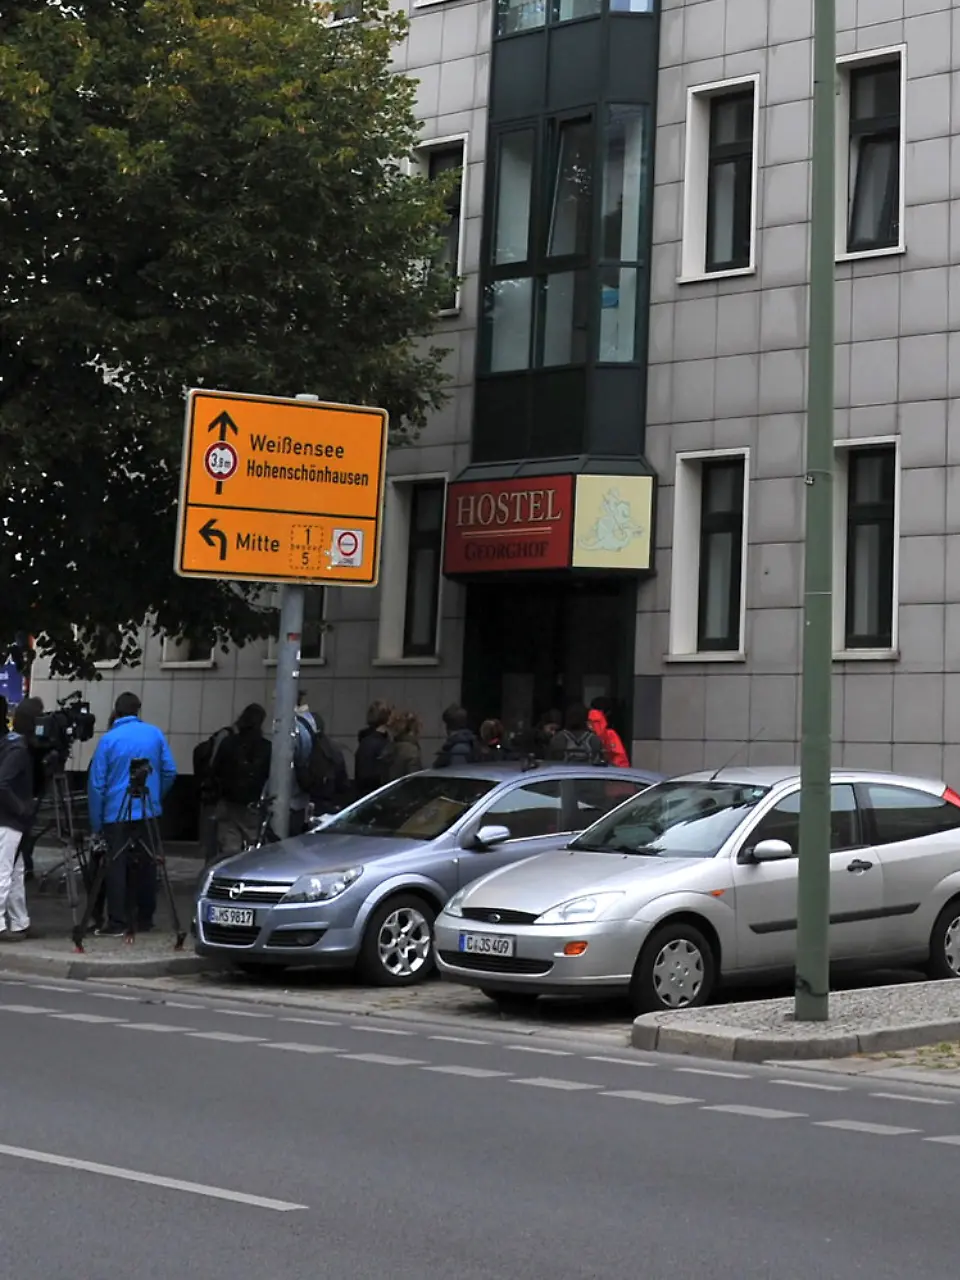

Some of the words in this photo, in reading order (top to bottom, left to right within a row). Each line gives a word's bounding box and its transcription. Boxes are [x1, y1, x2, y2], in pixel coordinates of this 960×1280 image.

[250, 434, 345, 459] Weißensee
[247, 459, 369, 486] Hohenschönhausen
[456, 489, 562, 527] HOSTEL
[236, 532, 281, 552] Mitte
[301, 552, 310, 565] 5
[230, 910, 253, 924] 9817
[492, 939, 509, 954] 409
